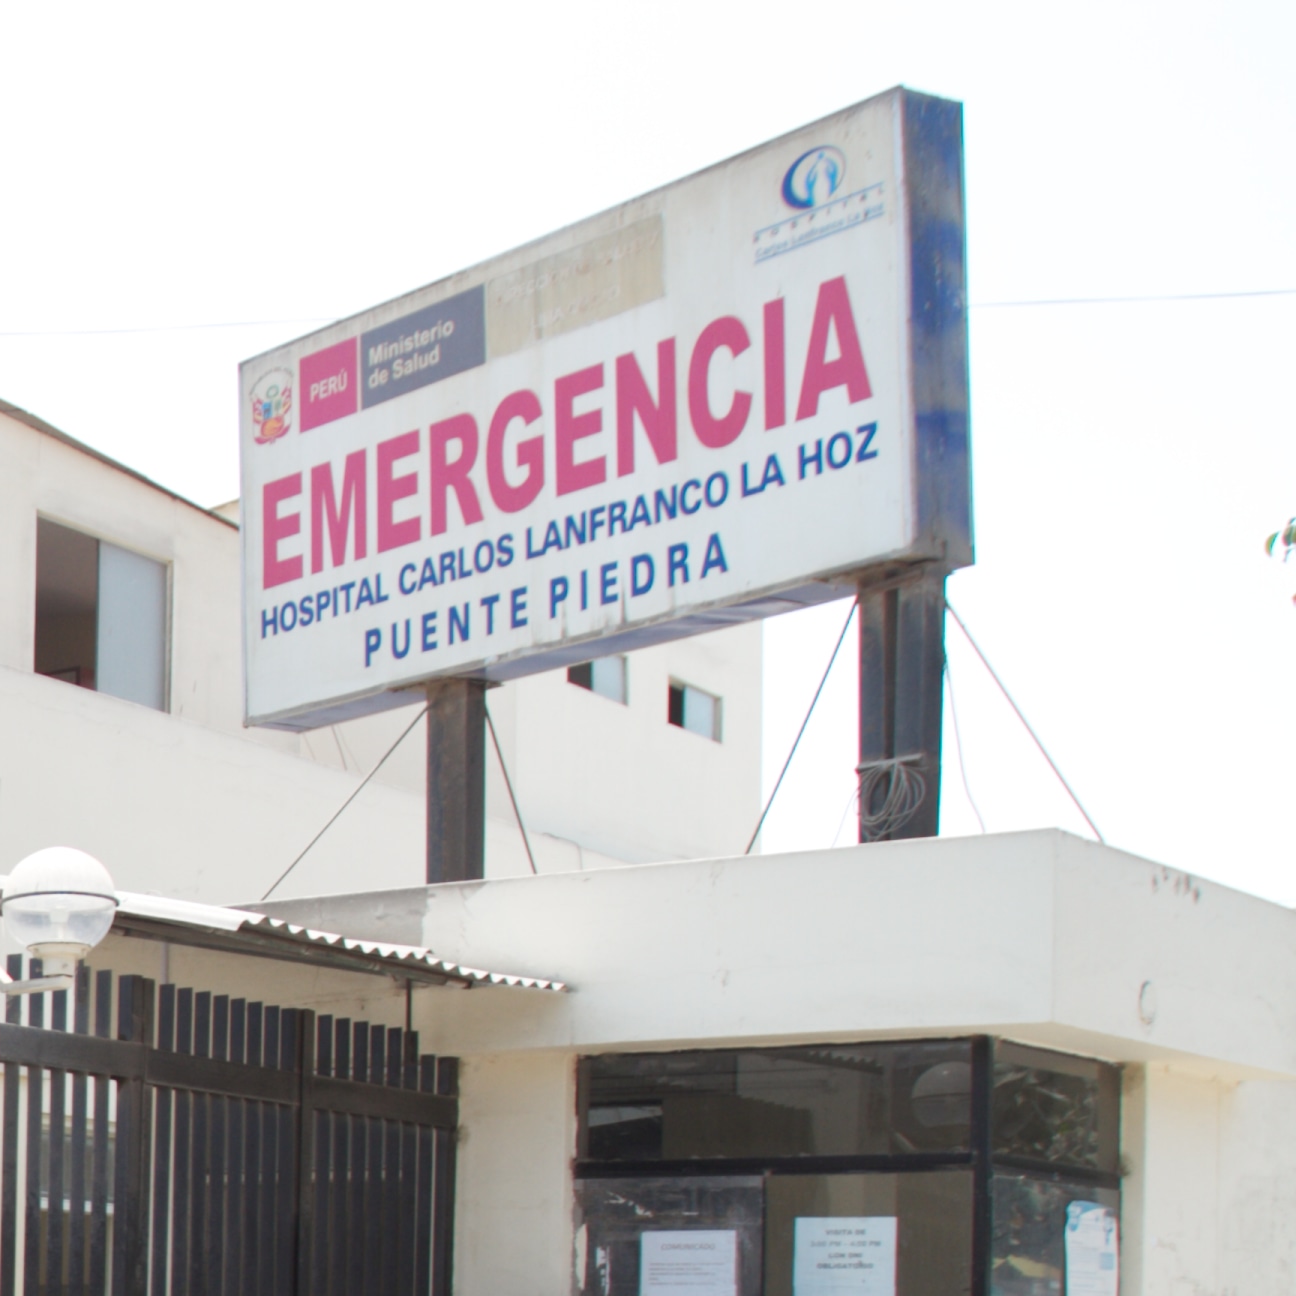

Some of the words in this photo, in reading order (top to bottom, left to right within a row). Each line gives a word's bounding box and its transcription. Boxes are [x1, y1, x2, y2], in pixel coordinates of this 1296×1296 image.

[310, 368, 349, 402] PERÚ
[368, 319, 455, 366] Ministerio
[368, 369, 389, 389] de
[392, 344, 441, 379] Salud
[263, 274, 873, 590] EMERGENCIA
[261, 572, 389, 640] HOSPITAL
[398, 532, 514, 596] CARLOS
[525, 470, 730, 560] LANFRANCO
[741, 452, 786, 498] LA
[798, 420, 879, 481] HOZ
[364, 586, 528, 668] PUENTE
[549, 532, 729, 620] PIEDRA
